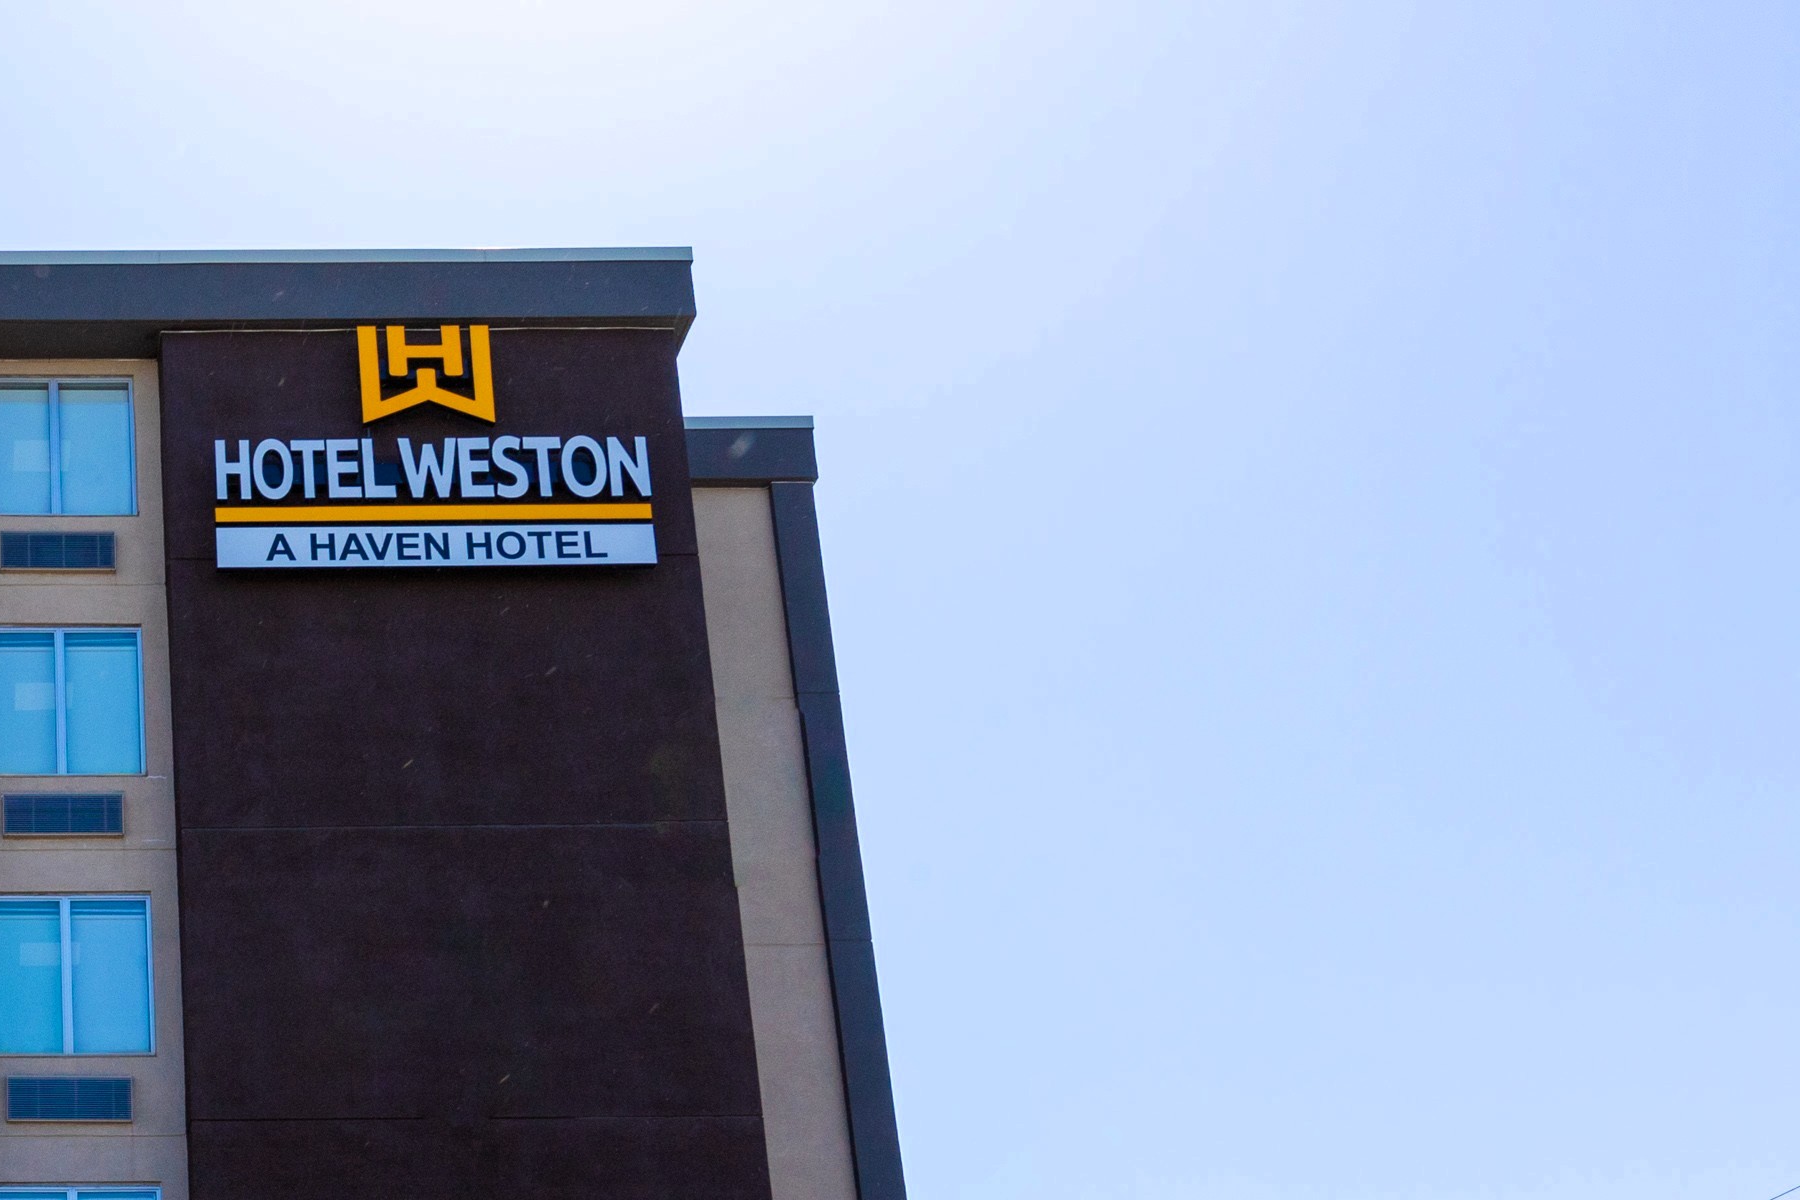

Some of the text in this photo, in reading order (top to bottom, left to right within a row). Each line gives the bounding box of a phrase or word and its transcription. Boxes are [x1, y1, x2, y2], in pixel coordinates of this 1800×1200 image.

[214, 435, 652, 500] HOTEL WESTON
[266, 530, 608, 561] A HAVEN HOTEL
